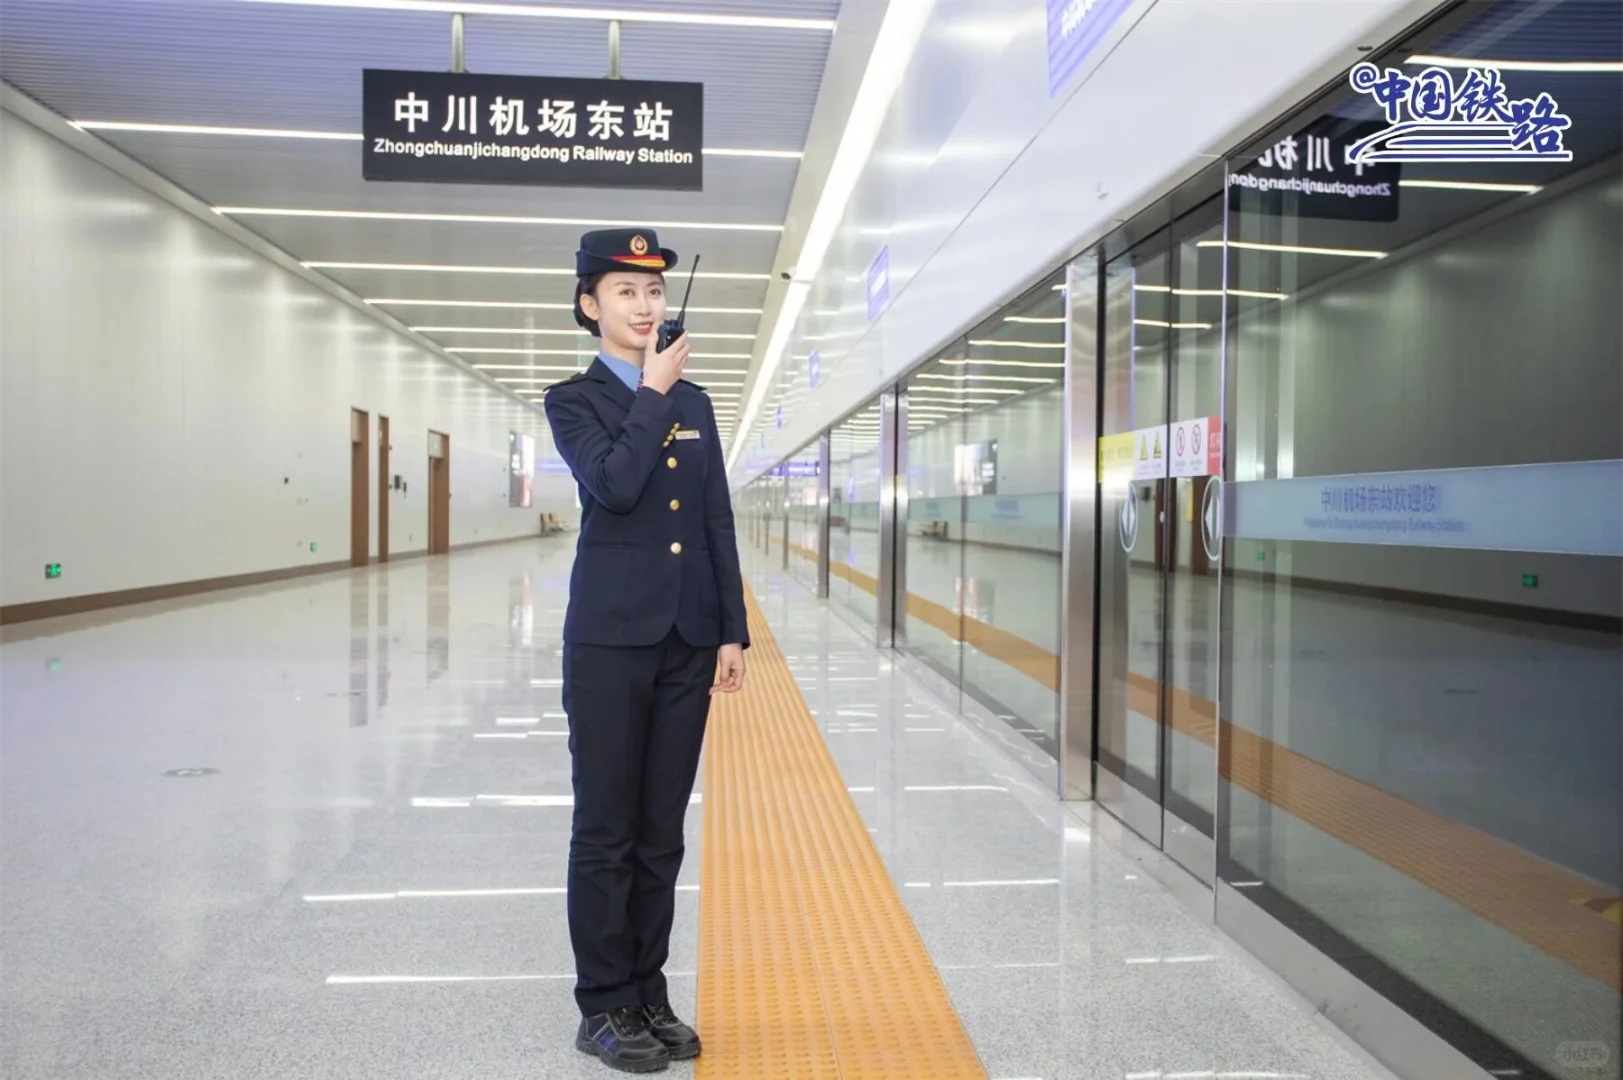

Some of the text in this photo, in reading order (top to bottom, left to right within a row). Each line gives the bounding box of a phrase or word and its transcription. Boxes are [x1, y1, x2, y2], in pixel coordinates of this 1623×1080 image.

[394, 92, 673, 141] 中川机场东站
[373, 138, 693, 165] Zhongchuanjichangdong Railway Station
